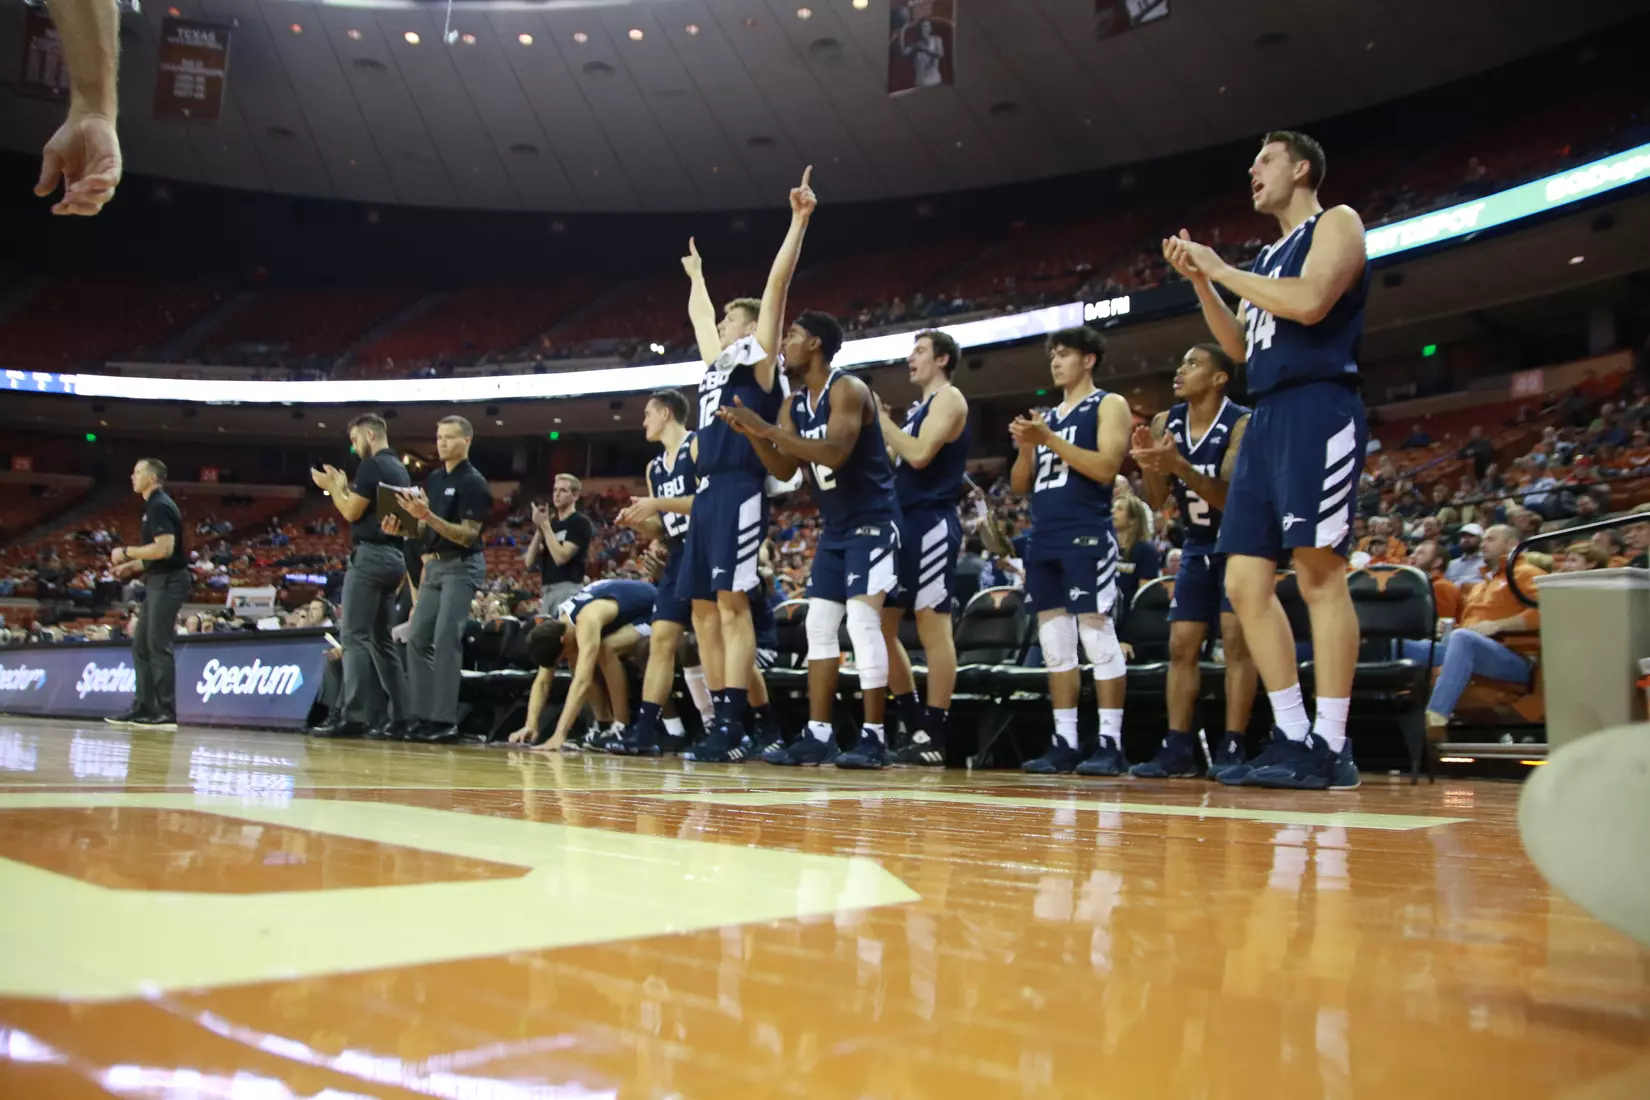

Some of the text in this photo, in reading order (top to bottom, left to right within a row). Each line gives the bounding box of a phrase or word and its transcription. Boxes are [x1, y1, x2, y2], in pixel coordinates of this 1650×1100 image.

[698, 388, 722, 431] 12
[657, 474, 685, 499] CBU
[1034, 452, 1069, 493] 23
[76, 661, 136, 699] Spectru
[196, 658, 301, 703] Spectrum
